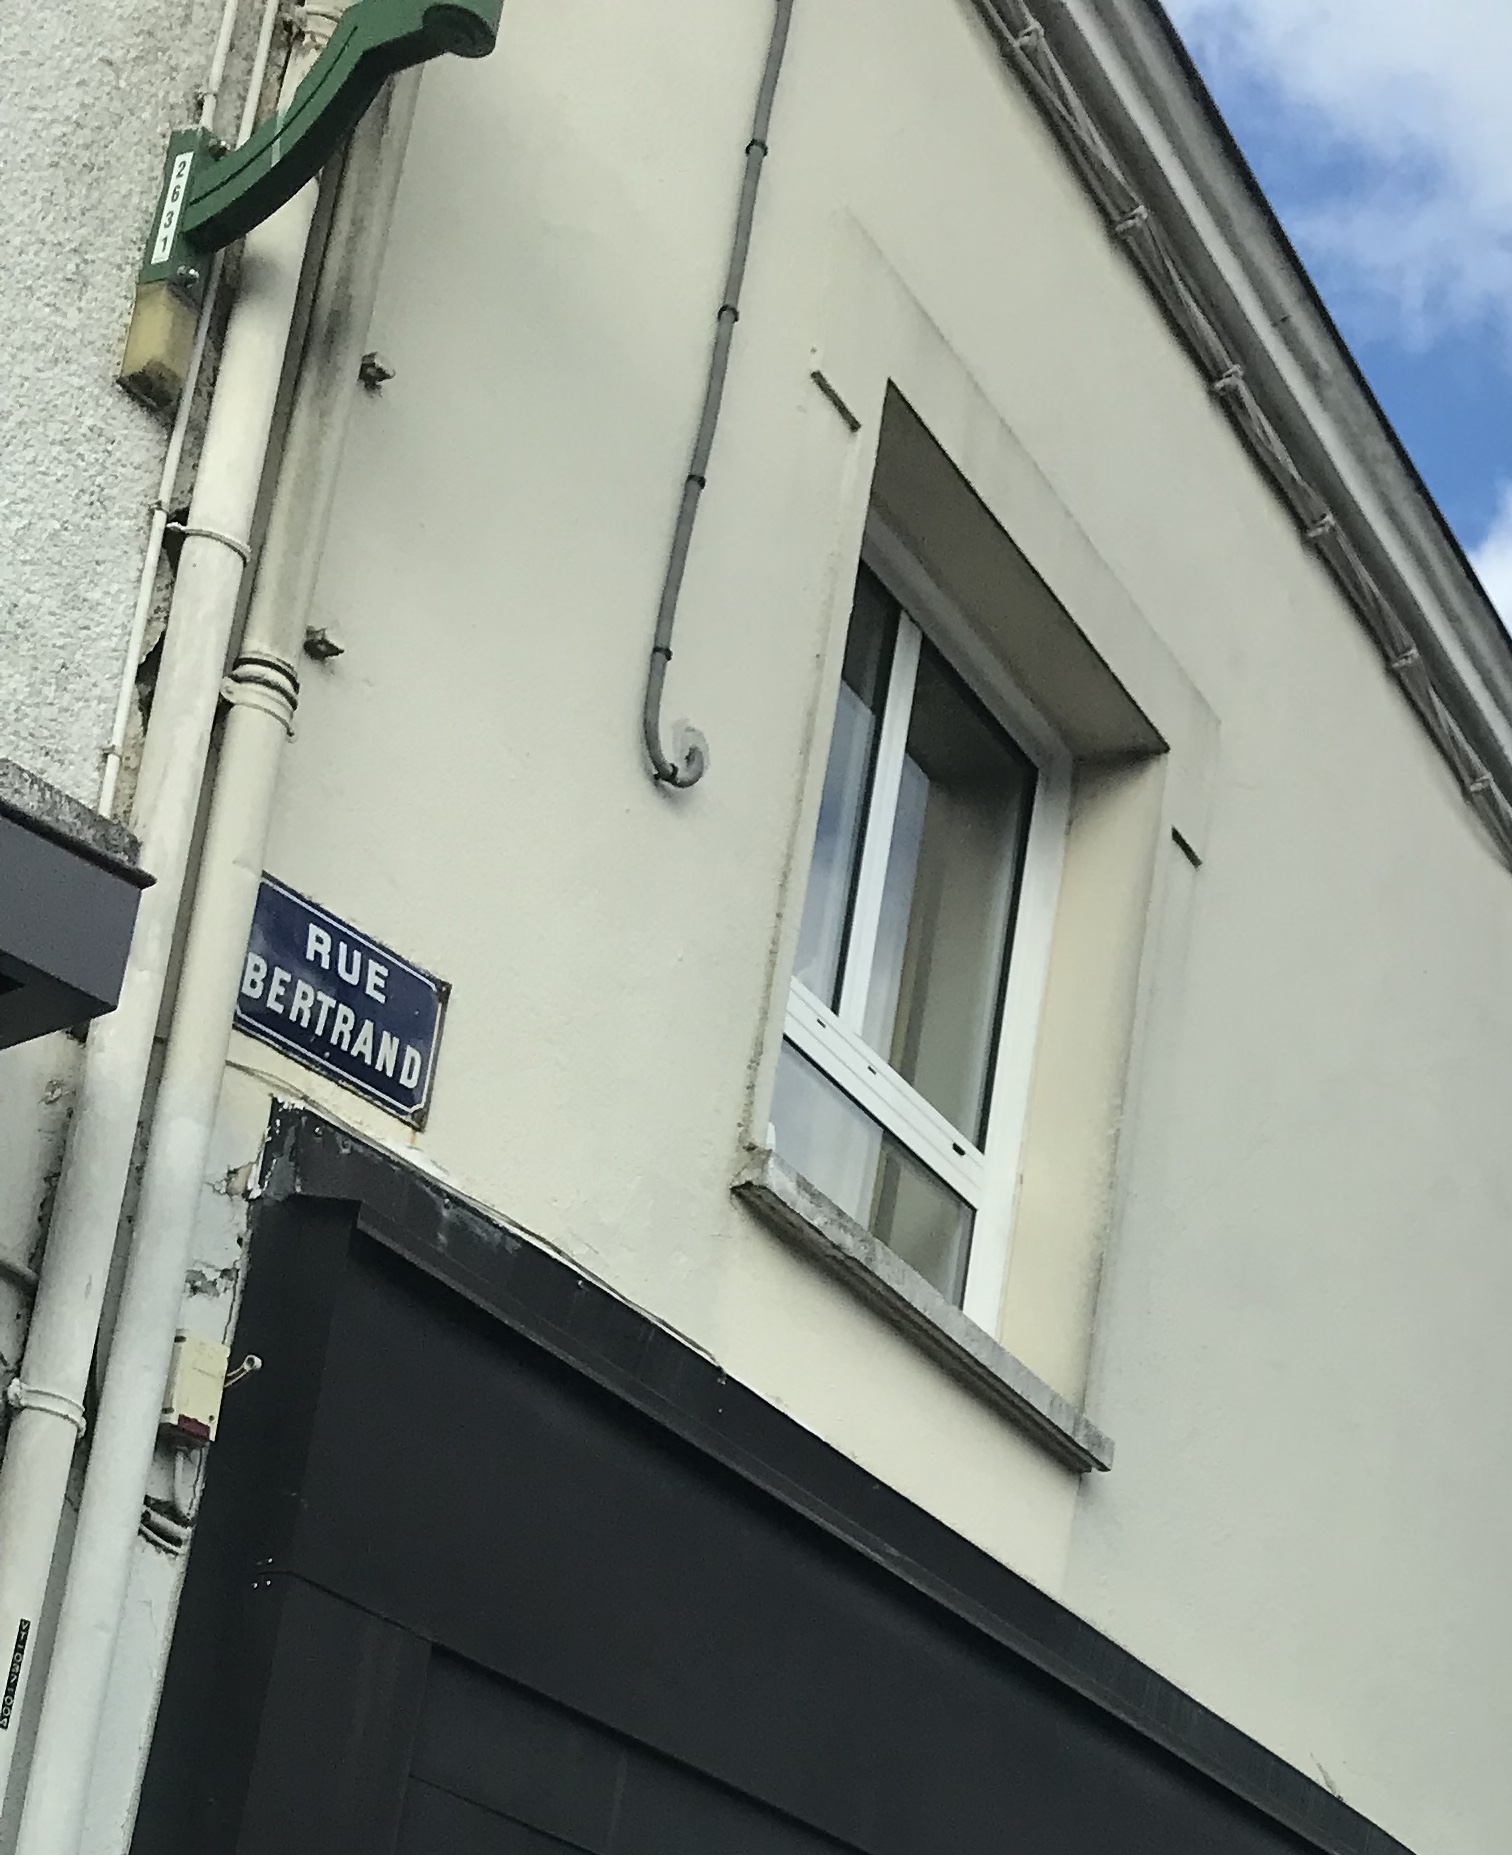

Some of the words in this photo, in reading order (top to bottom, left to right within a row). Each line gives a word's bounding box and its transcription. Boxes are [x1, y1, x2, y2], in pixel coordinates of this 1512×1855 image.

[161, 160, 186, 253] 2631
[306, 922, 389, 1004] RUE
[240, 952, 423, 1091] BERTRAND
